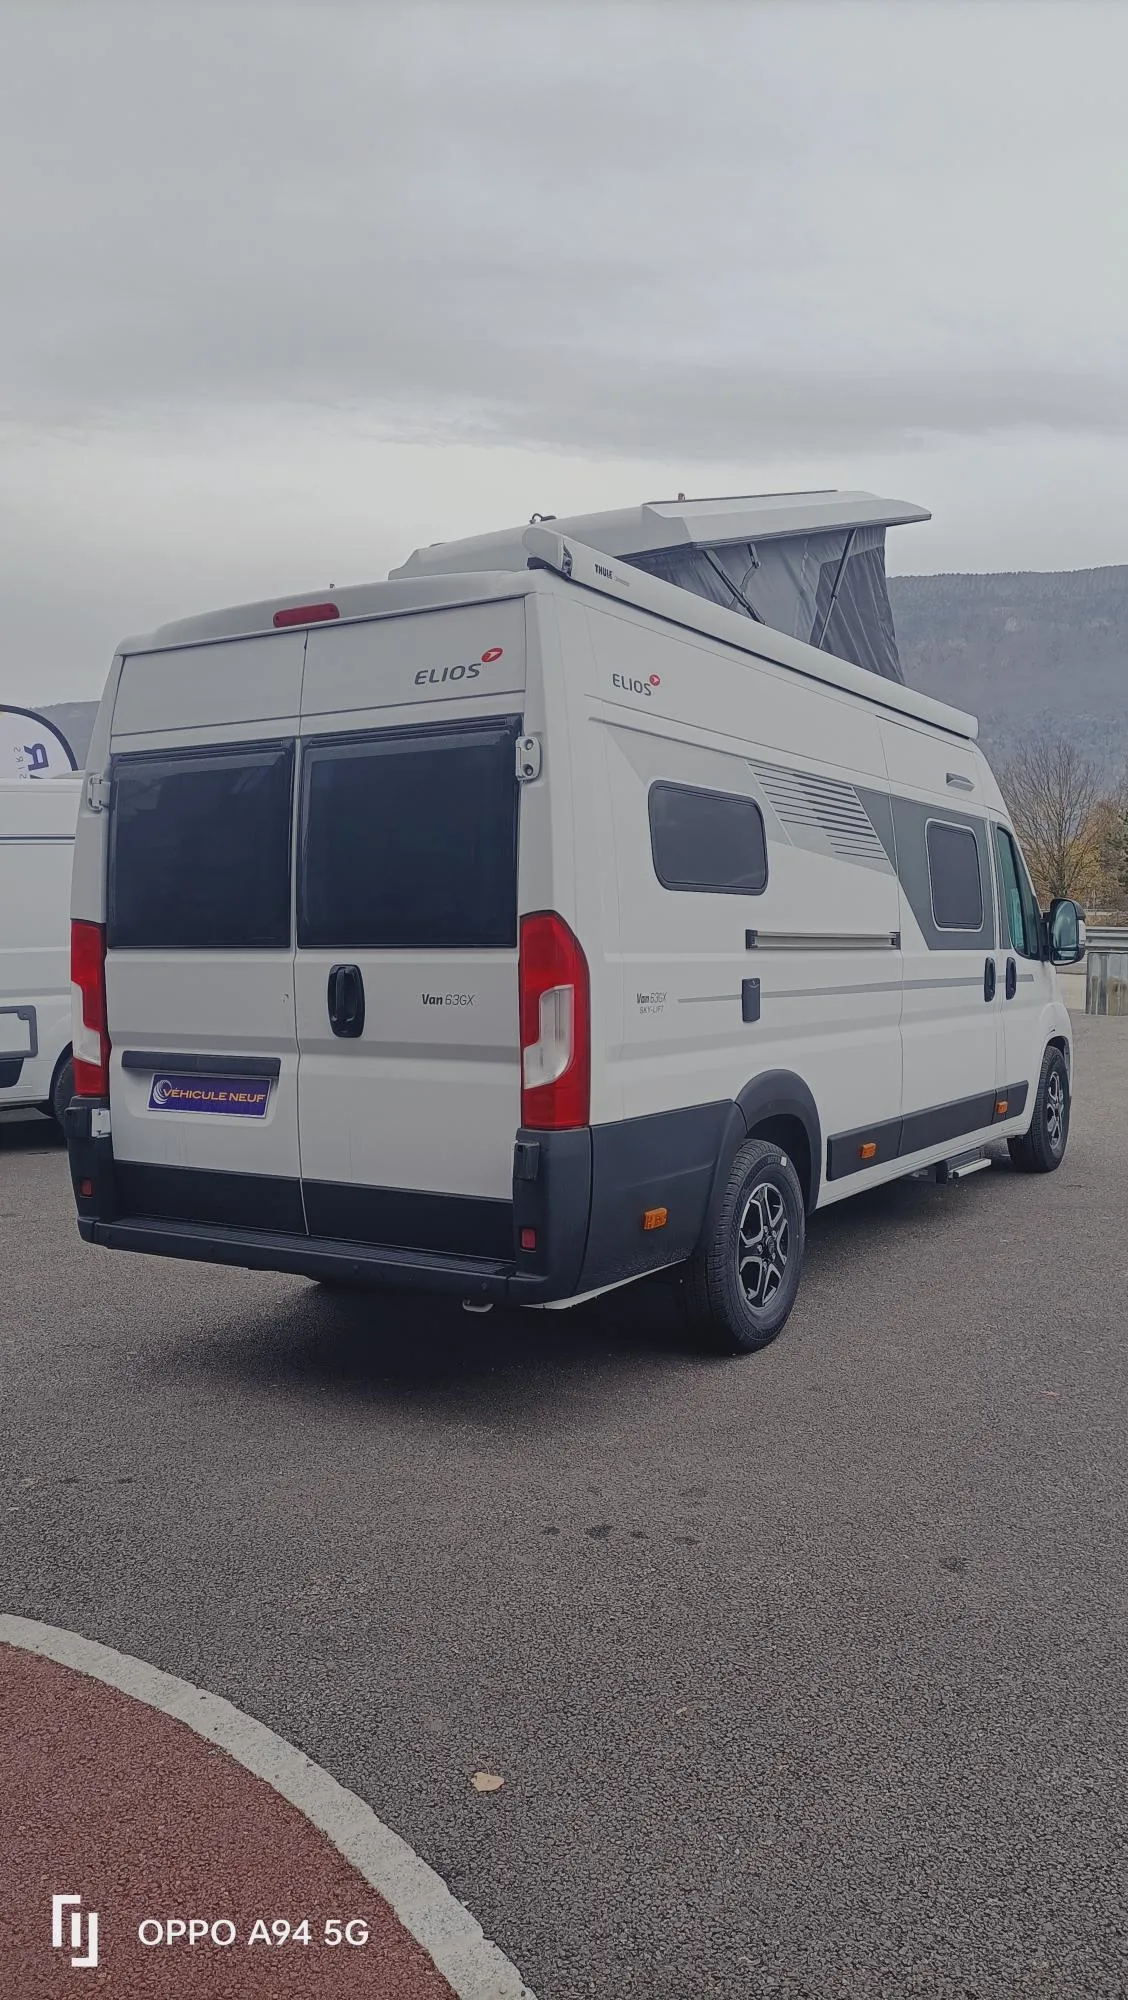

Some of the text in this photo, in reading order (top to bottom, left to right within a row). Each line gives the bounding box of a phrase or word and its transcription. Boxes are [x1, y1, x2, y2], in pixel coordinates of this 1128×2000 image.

[594, 563, 613, 580] THULE
[414, 663, 482, 685] ELIOS
[612, 673, 652, 697] ELIOS
[421, 993, 476, 1006] Van 63GX
[636, 992, 650, 1004] Van
[228, 1092, 266, 1104] NEUF
